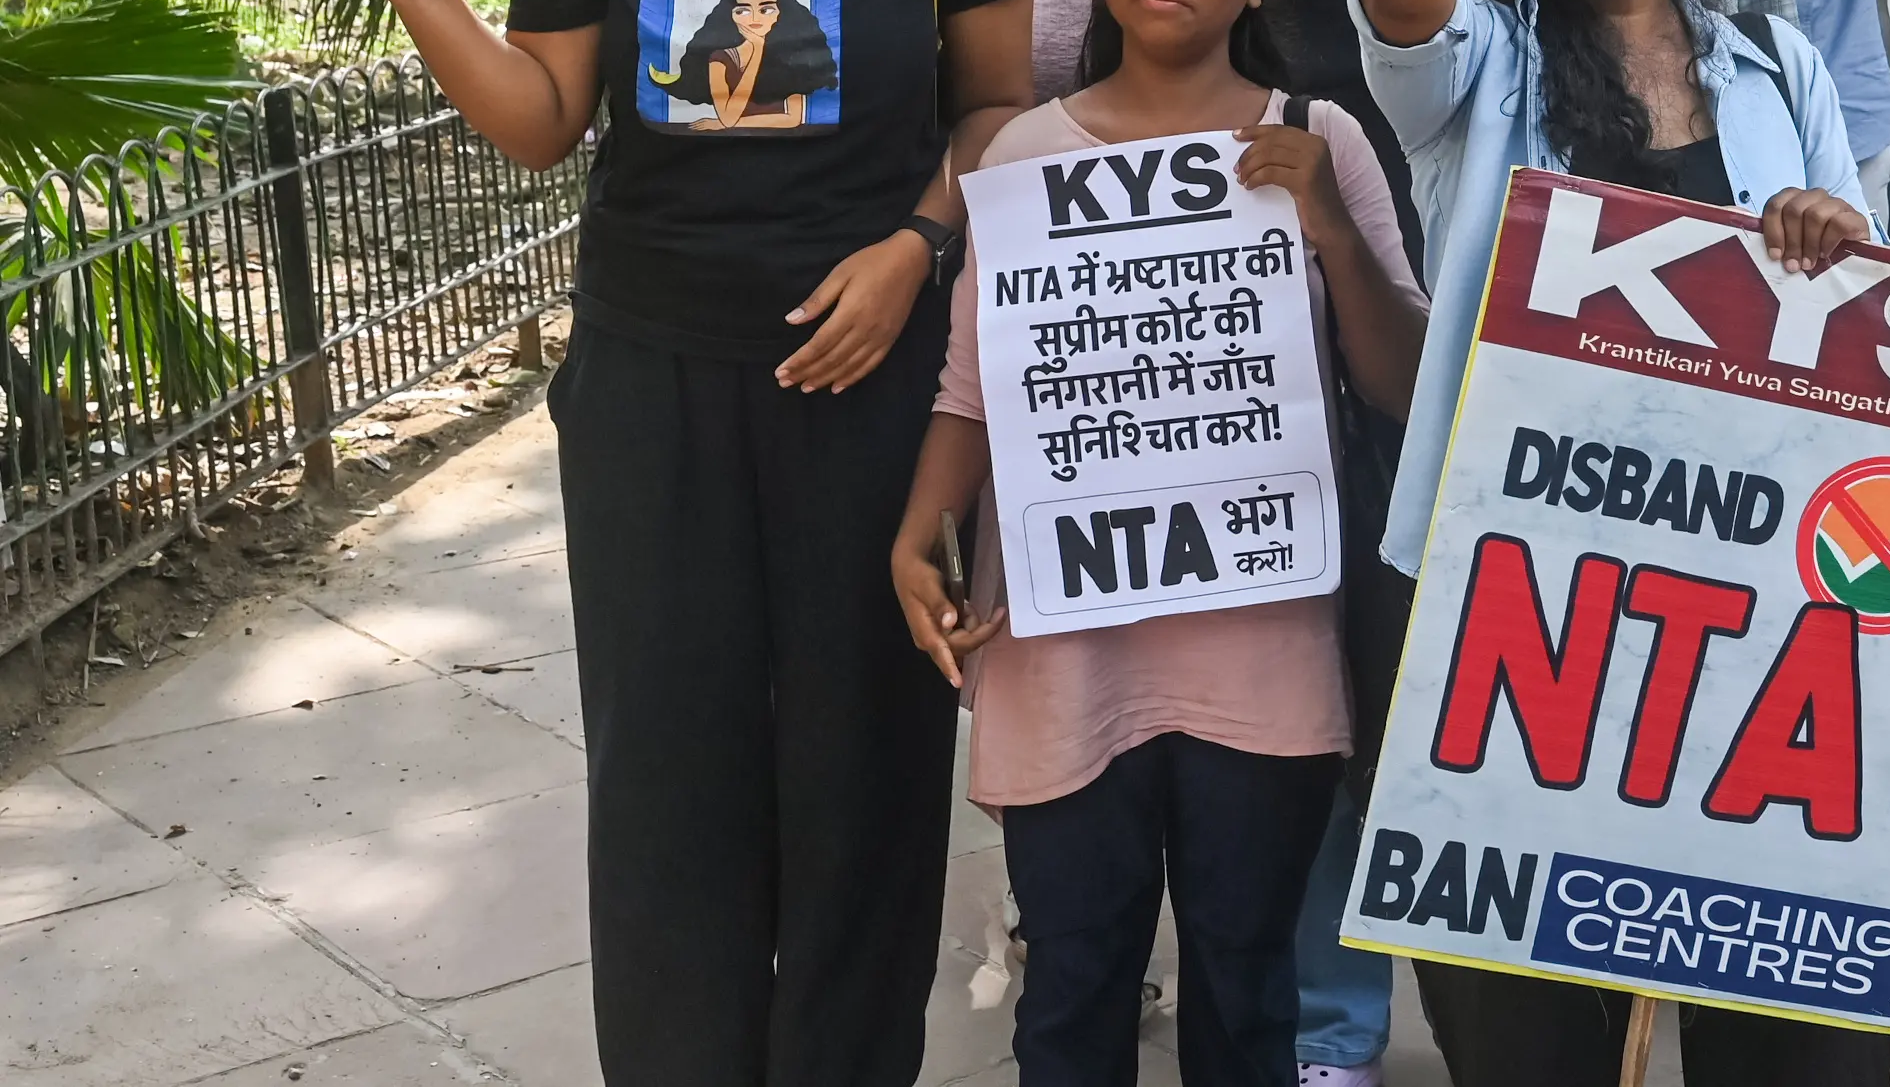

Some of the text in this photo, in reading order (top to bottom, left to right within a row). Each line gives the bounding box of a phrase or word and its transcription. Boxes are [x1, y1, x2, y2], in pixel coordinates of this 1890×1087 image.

[1042, 142, 1228, 228] KYS
[996, 228, 1295, 306] NTA में भ्रष्टाचार की
[1029, 287, 1263, 370] सुप्रीम कोर्ट की
[1164, 350, 1196, 397] में
[1200, 342, 1276, 392] जाँच
[1577, 332, 1712, 379] Krantikari
[1719, 360, 1782, 394] Yuva
[1038, 396, 1283, 483] सुनिश्चित करो!
[1221, 483, 1295, 536] भंग
[1501, 426, 1786, 547] DISBAND
[1055, 501, 1220, 599] NTA
[1233, 542, 1294, 576] करो!
[1430, 531, 1865, 843] NTA
[1358, 827, 1538, 943] BAN
[1564, 911, 1876, 997] CENTRES
